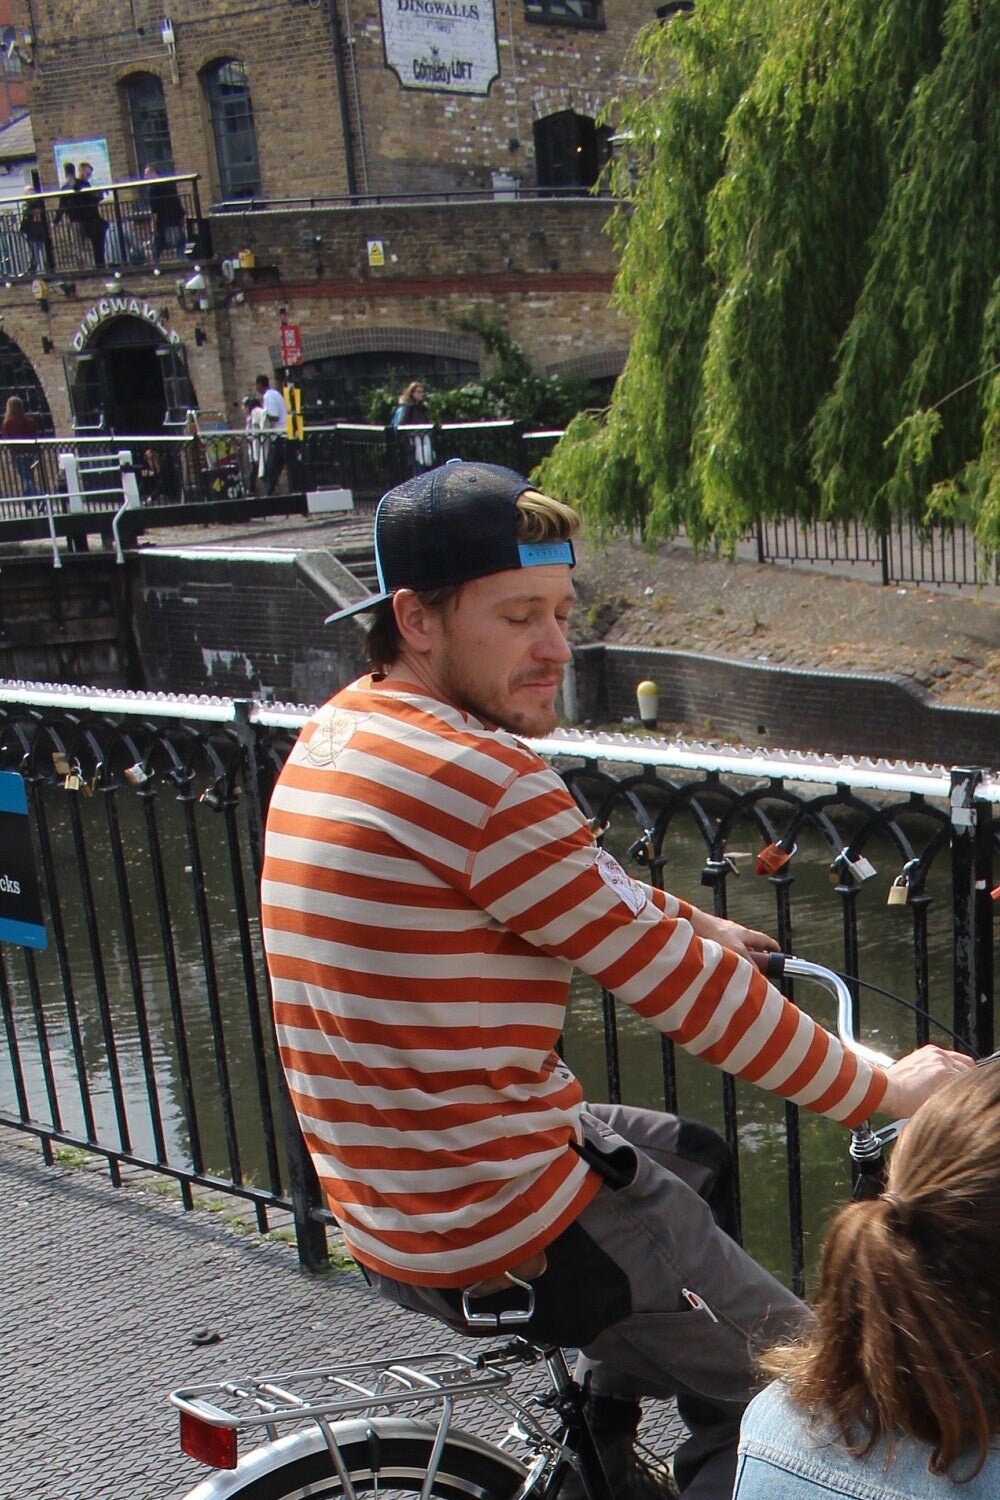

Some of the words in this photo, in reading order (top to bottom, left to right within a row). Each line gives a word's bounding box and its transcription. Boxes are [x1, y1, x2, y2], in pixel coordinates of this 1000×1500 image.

[398, 0, 479, 20] DINGWALLS
[413, 58, 450, 84] Comedy
[451, 60, 473, 79] LOFT
